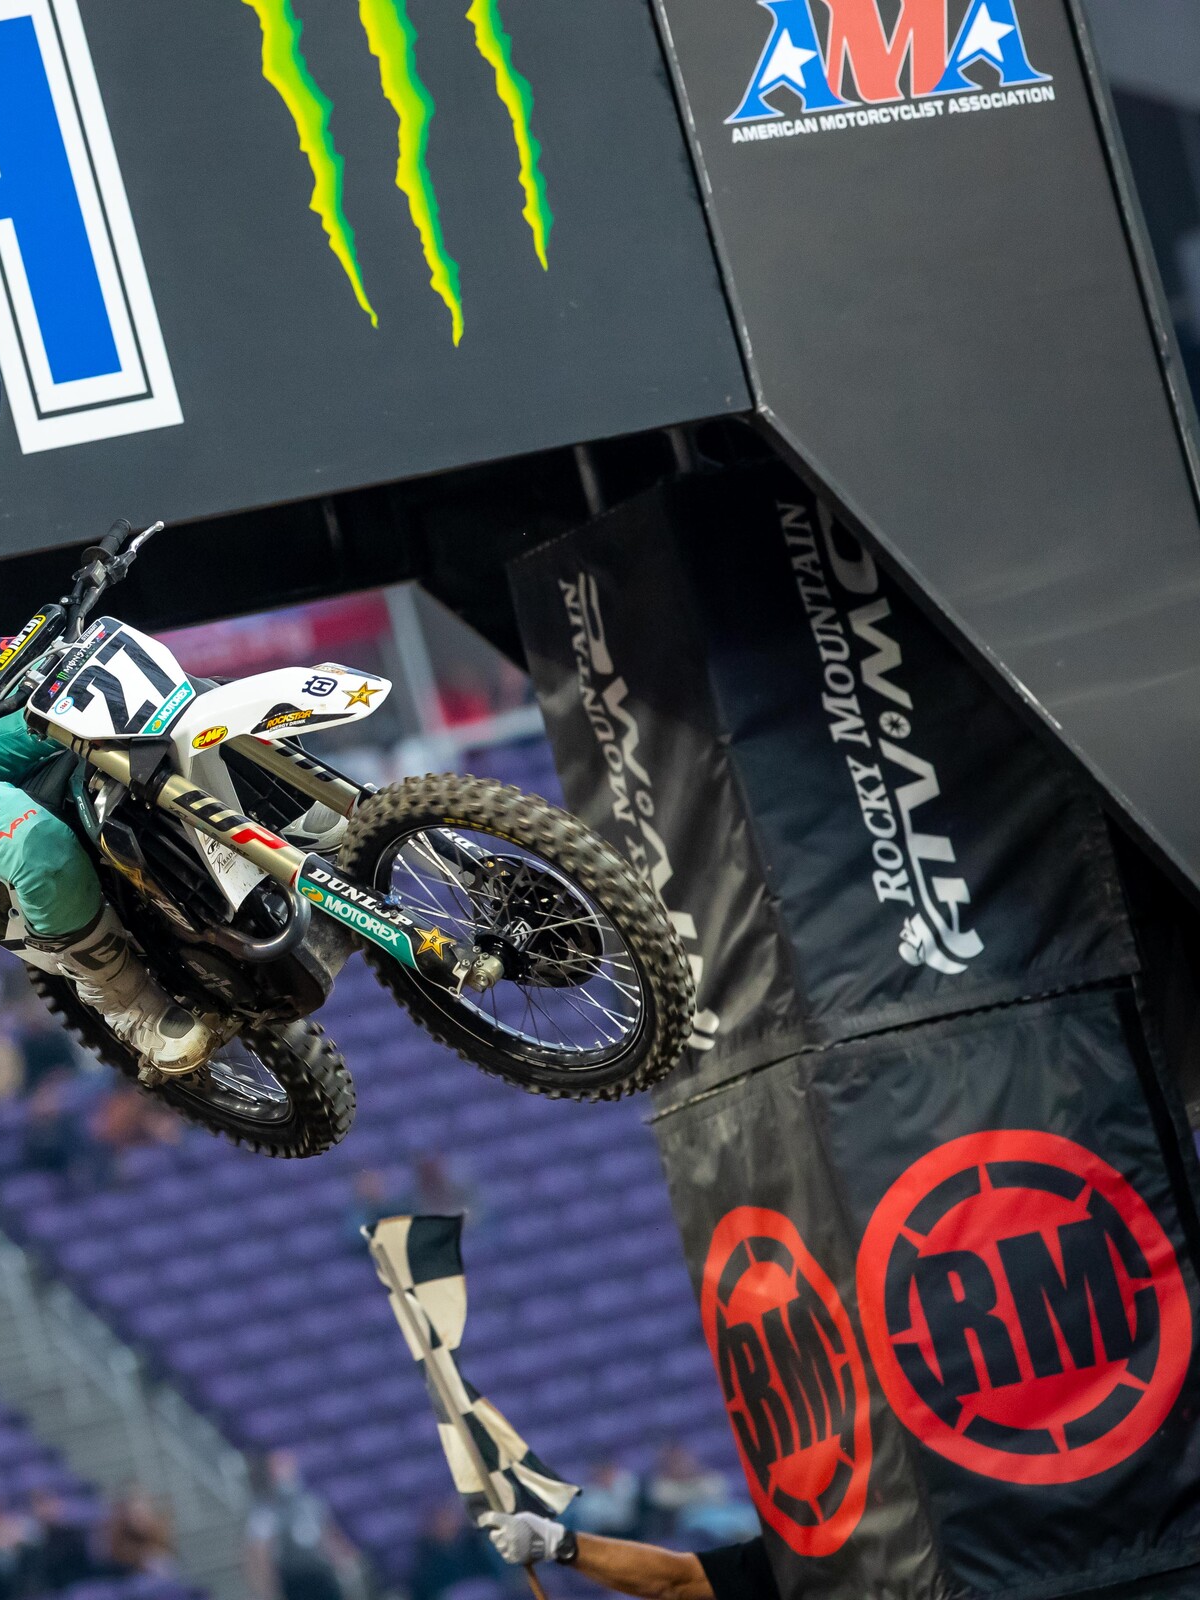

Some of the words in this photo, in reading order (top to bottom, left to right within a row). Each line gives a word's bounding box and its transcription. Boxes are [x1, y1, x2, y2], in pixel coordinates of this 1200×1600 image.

[723, 0, 1054, 125] AMA
[731, 115, 819, 144] AMERICAN
[819, 100, 945, 130] MOTORCYCLIST
[947, 86, 1056, 115] ASSOCIATION
[777, 501, 874, 745] MOUNTAIN
[67, 630, 177, 734] 27
[157, 686, 191, 722] MOTOREX
[266, 709, 314, 729] ROCKSTAR
[558, 578, 638, 827] MOUNTAIN
[192, 726, 228, 749] FMF
[847, 756, 916, 906] ROCKY
[324, 895, 401, 947] MOTOREX
